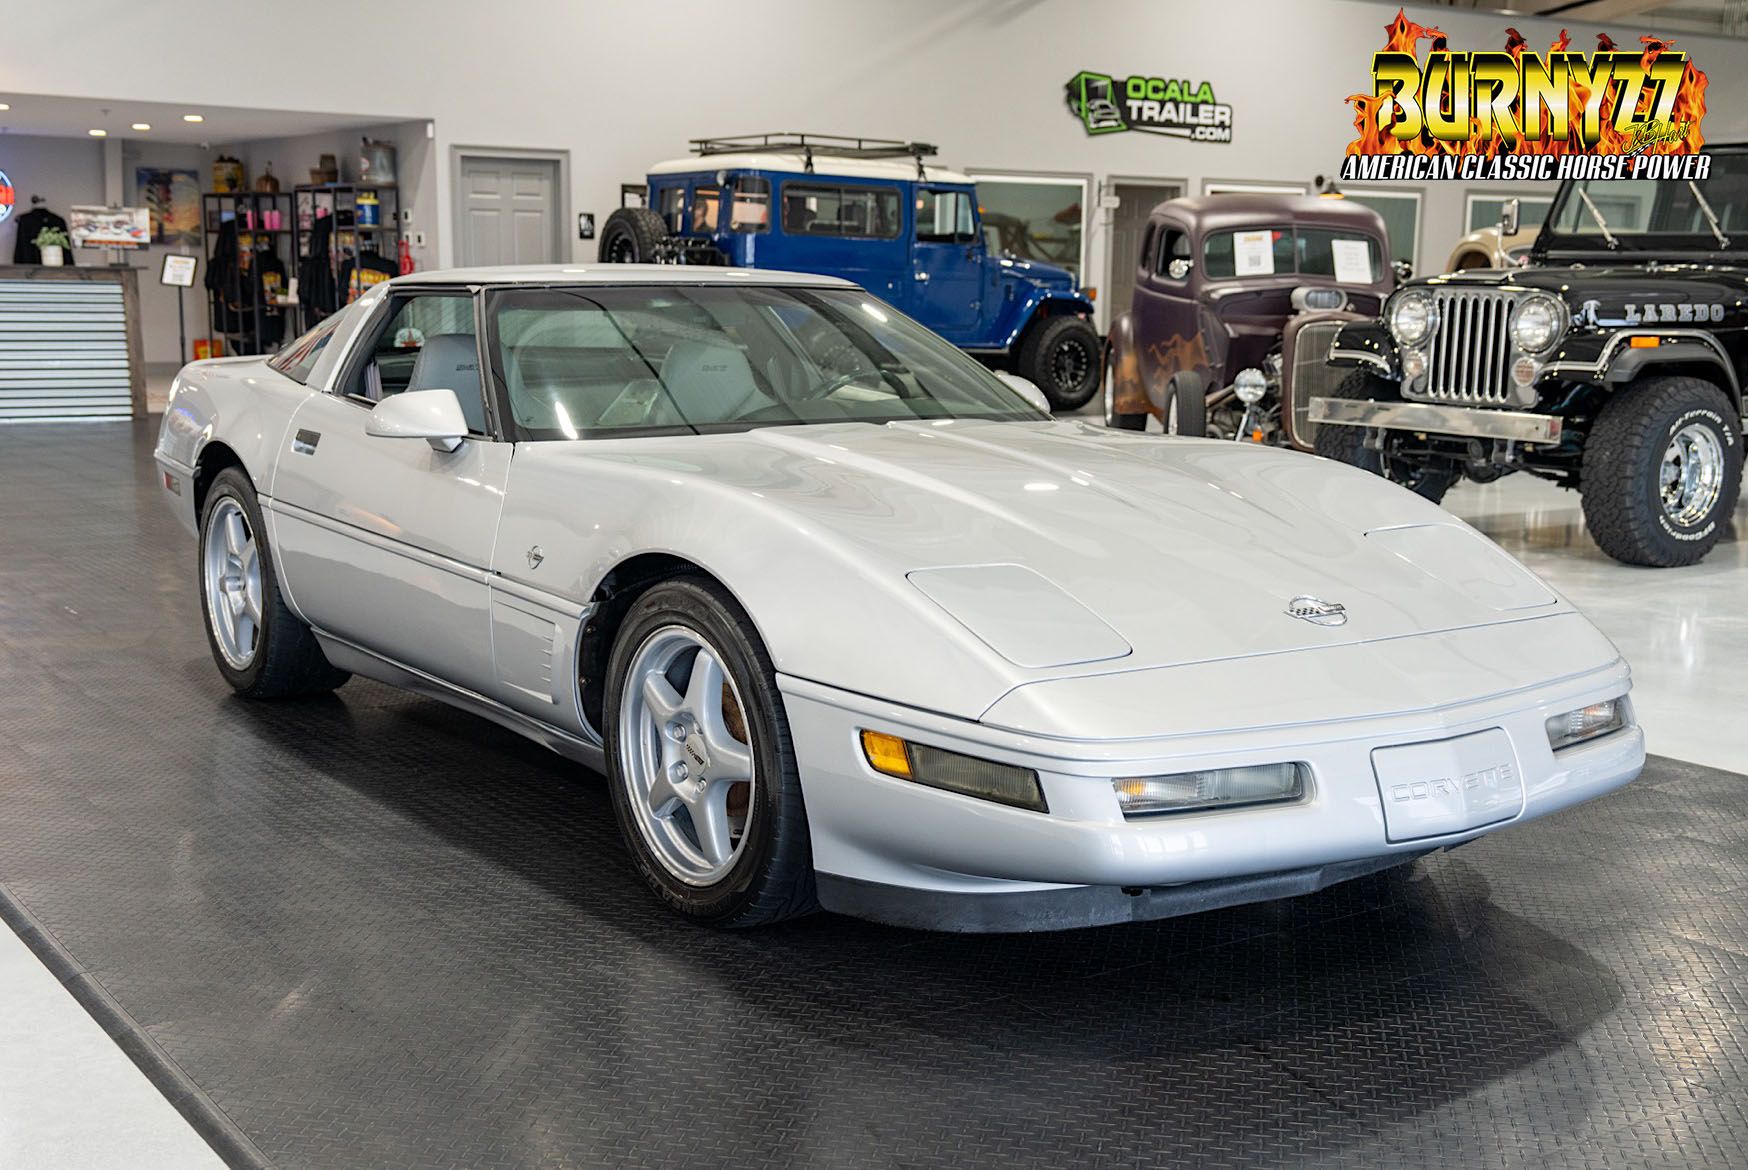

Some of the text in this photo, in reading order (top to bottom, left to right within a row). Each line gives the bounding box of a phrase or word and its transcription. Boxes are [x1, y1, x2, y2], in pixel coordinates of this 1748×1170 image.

[1126, 76, 1214, 103] OCALA
[1126, 99, 1231, 126] TRAILER
[1190, 126, 1231, 142] .COM
[1624, 304, 1725, 322] LAREDO
[1391, 763, 1513, 802] CORVETTE
